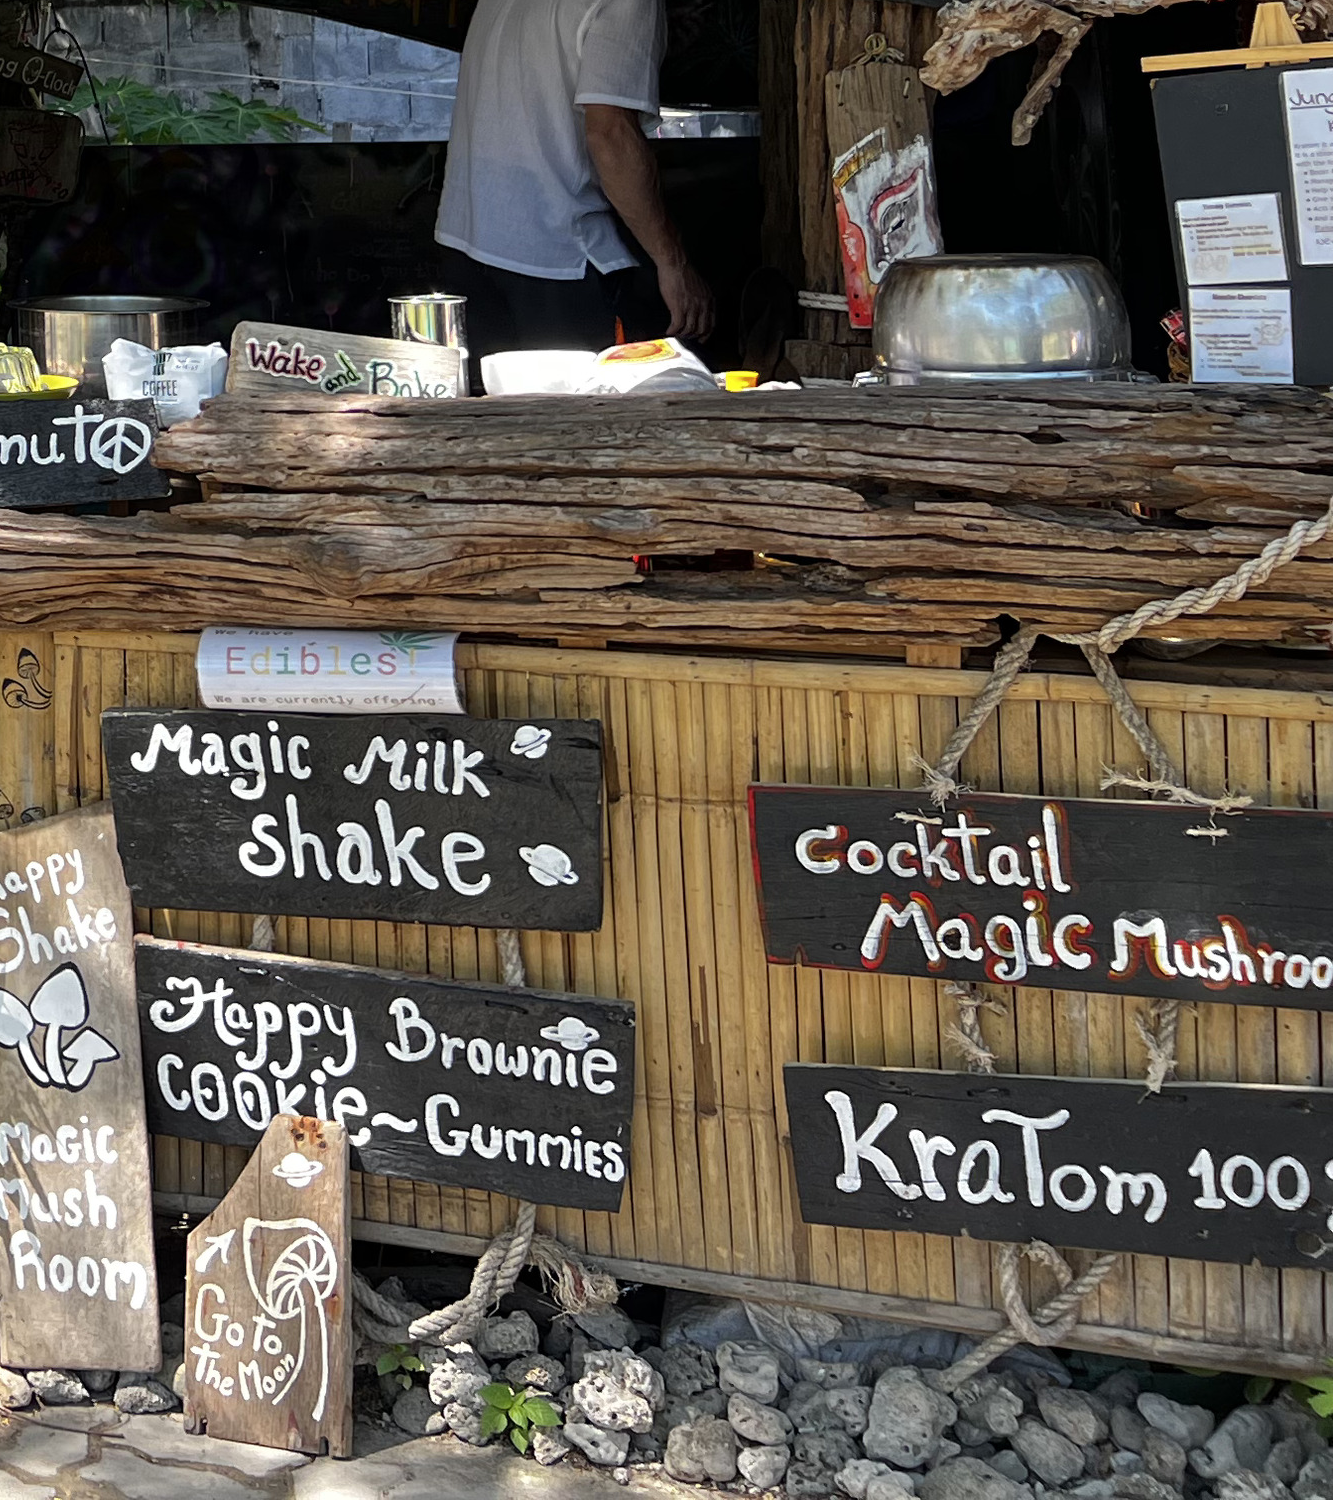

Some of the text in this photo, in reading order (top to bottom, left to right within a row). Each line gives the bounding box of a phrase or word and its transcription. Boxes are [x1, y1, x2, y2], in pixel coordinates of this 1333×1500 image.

[142, 380, 178, 396] COFFEE
[246, 340, 323, 381] Wake
[324, 350, 361, 393] and
[226, 646, 417, 676] Edibles!
[214, 695, 232, 703] We
[241, 696, 267, 704] are
[275, 695, 354, 706] currently
[131, 720, 491, 800] Magic Milk
[795, 803, 1075, 893] Cocktail
[861, 895, 1333, 990] Magic Mushroo
[150, 976, 618, 1095] Happy Brownie
[10, 1228, 148, 1310] Room
[194, 1283, 244, 1347] Go
[238, 1353, 295, 1401] Moon
